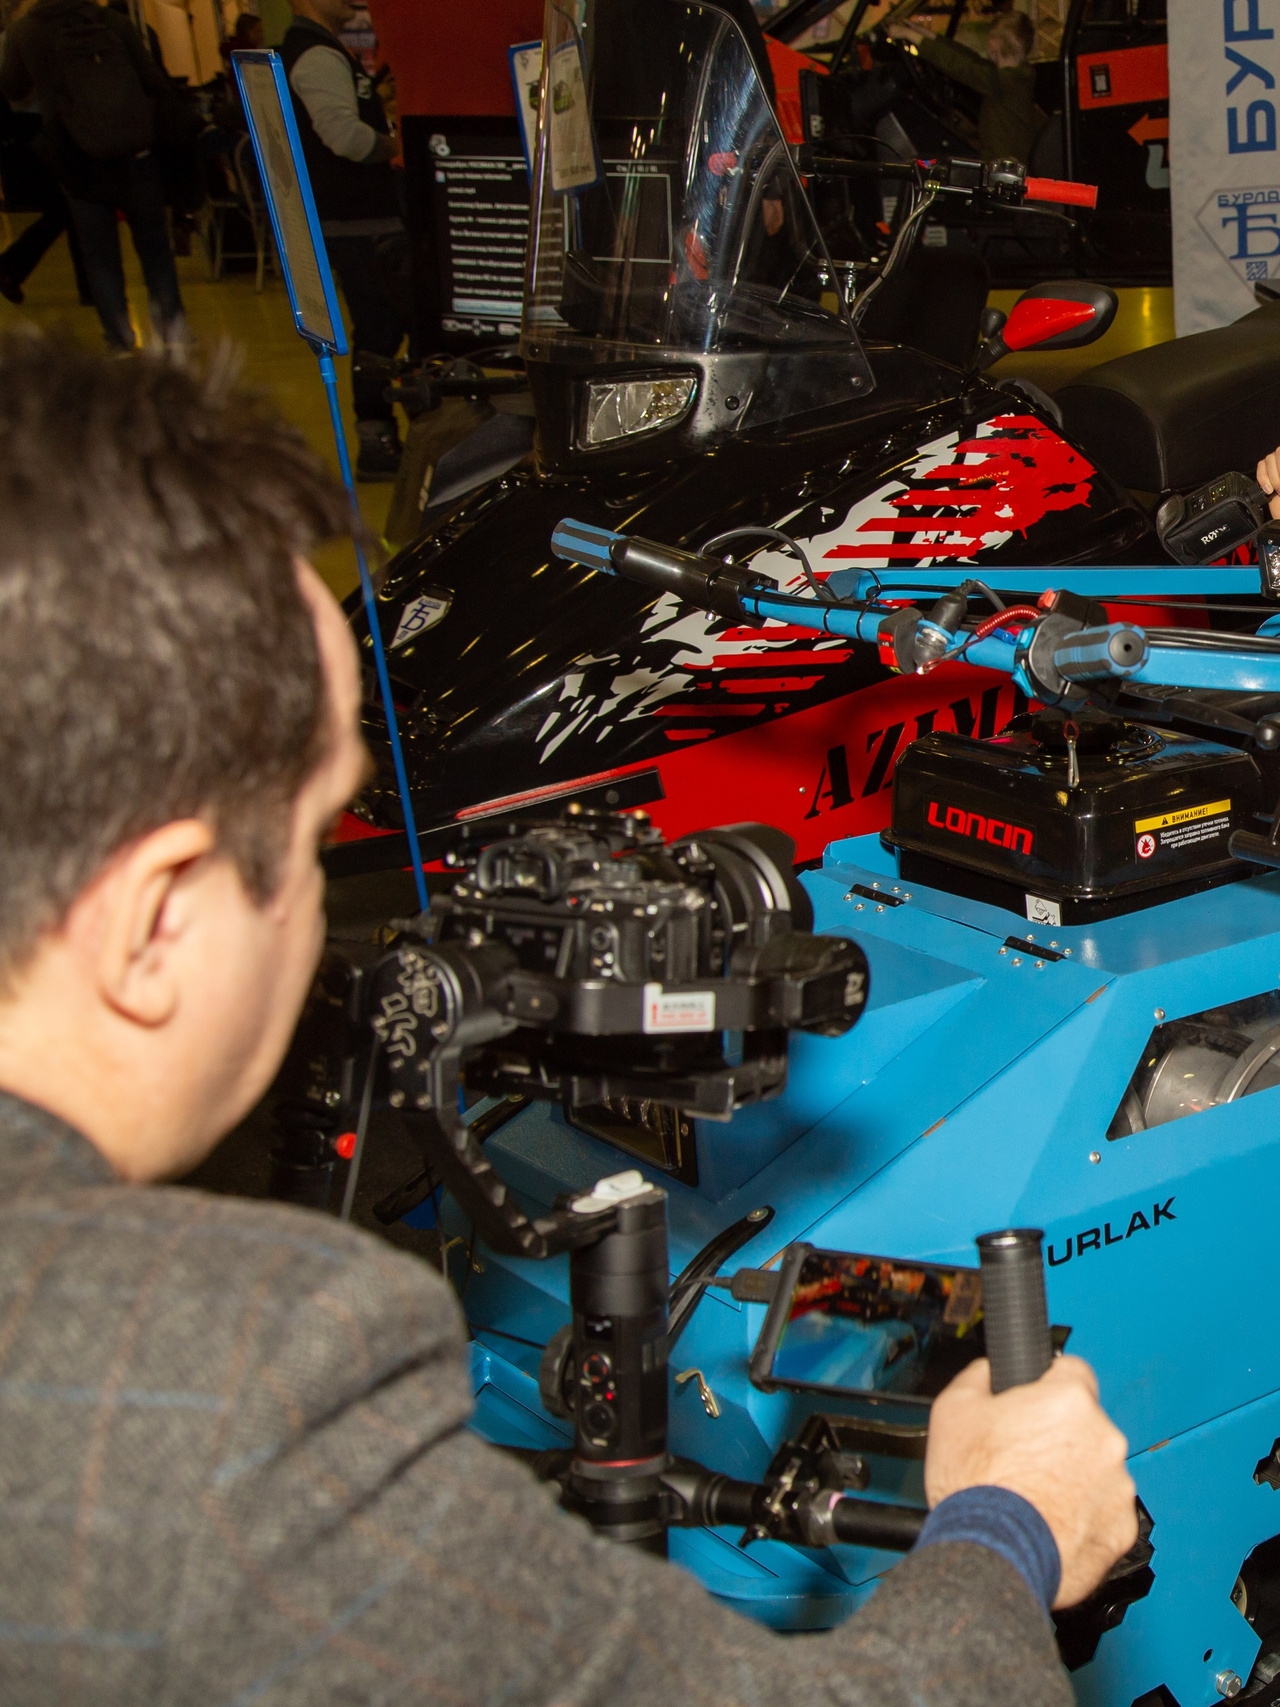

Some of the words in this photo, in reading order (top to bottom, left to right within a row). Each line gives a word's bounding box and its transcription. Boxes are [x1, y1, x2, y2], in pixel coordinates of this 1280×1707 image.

[927, 801, 1034, 856] LONCIN
[1171, 807, 1209, 823] ВНИМАНИЕ!
[1047, 1196, 1178, 1267] URLAK
